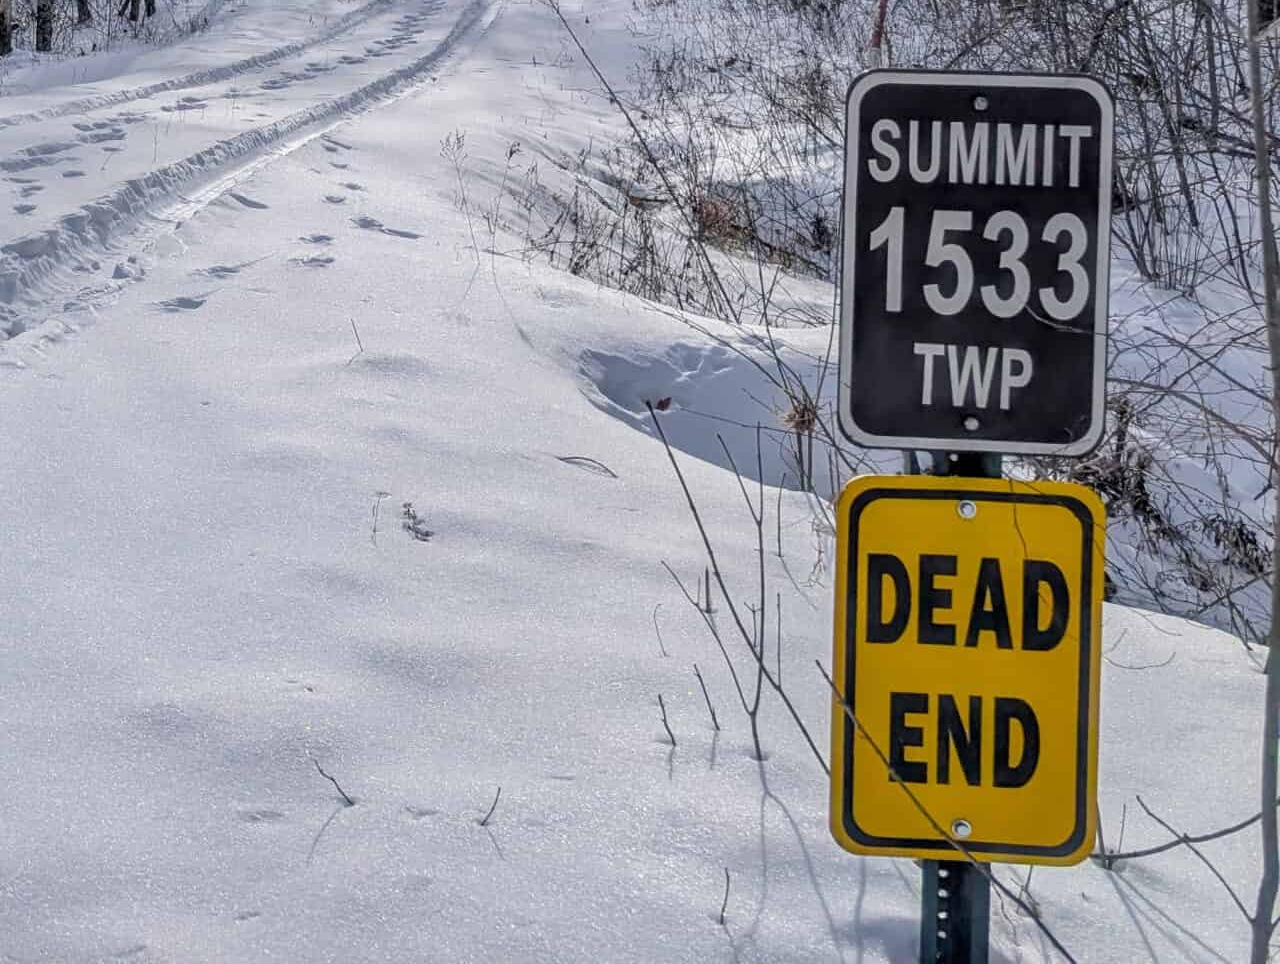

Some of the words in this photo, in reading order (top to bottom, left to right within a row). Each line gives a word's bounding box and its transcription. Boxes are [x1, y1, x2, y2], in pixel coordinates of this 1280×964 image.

[867, 118, 1093, 188] SUMMIT
[869, 206, 1091, 321] 1533
[913, 342, 1034, 411] TWP
[865, 552, 1070, 652] DEAD
[888, 692, 1041, 789] END
